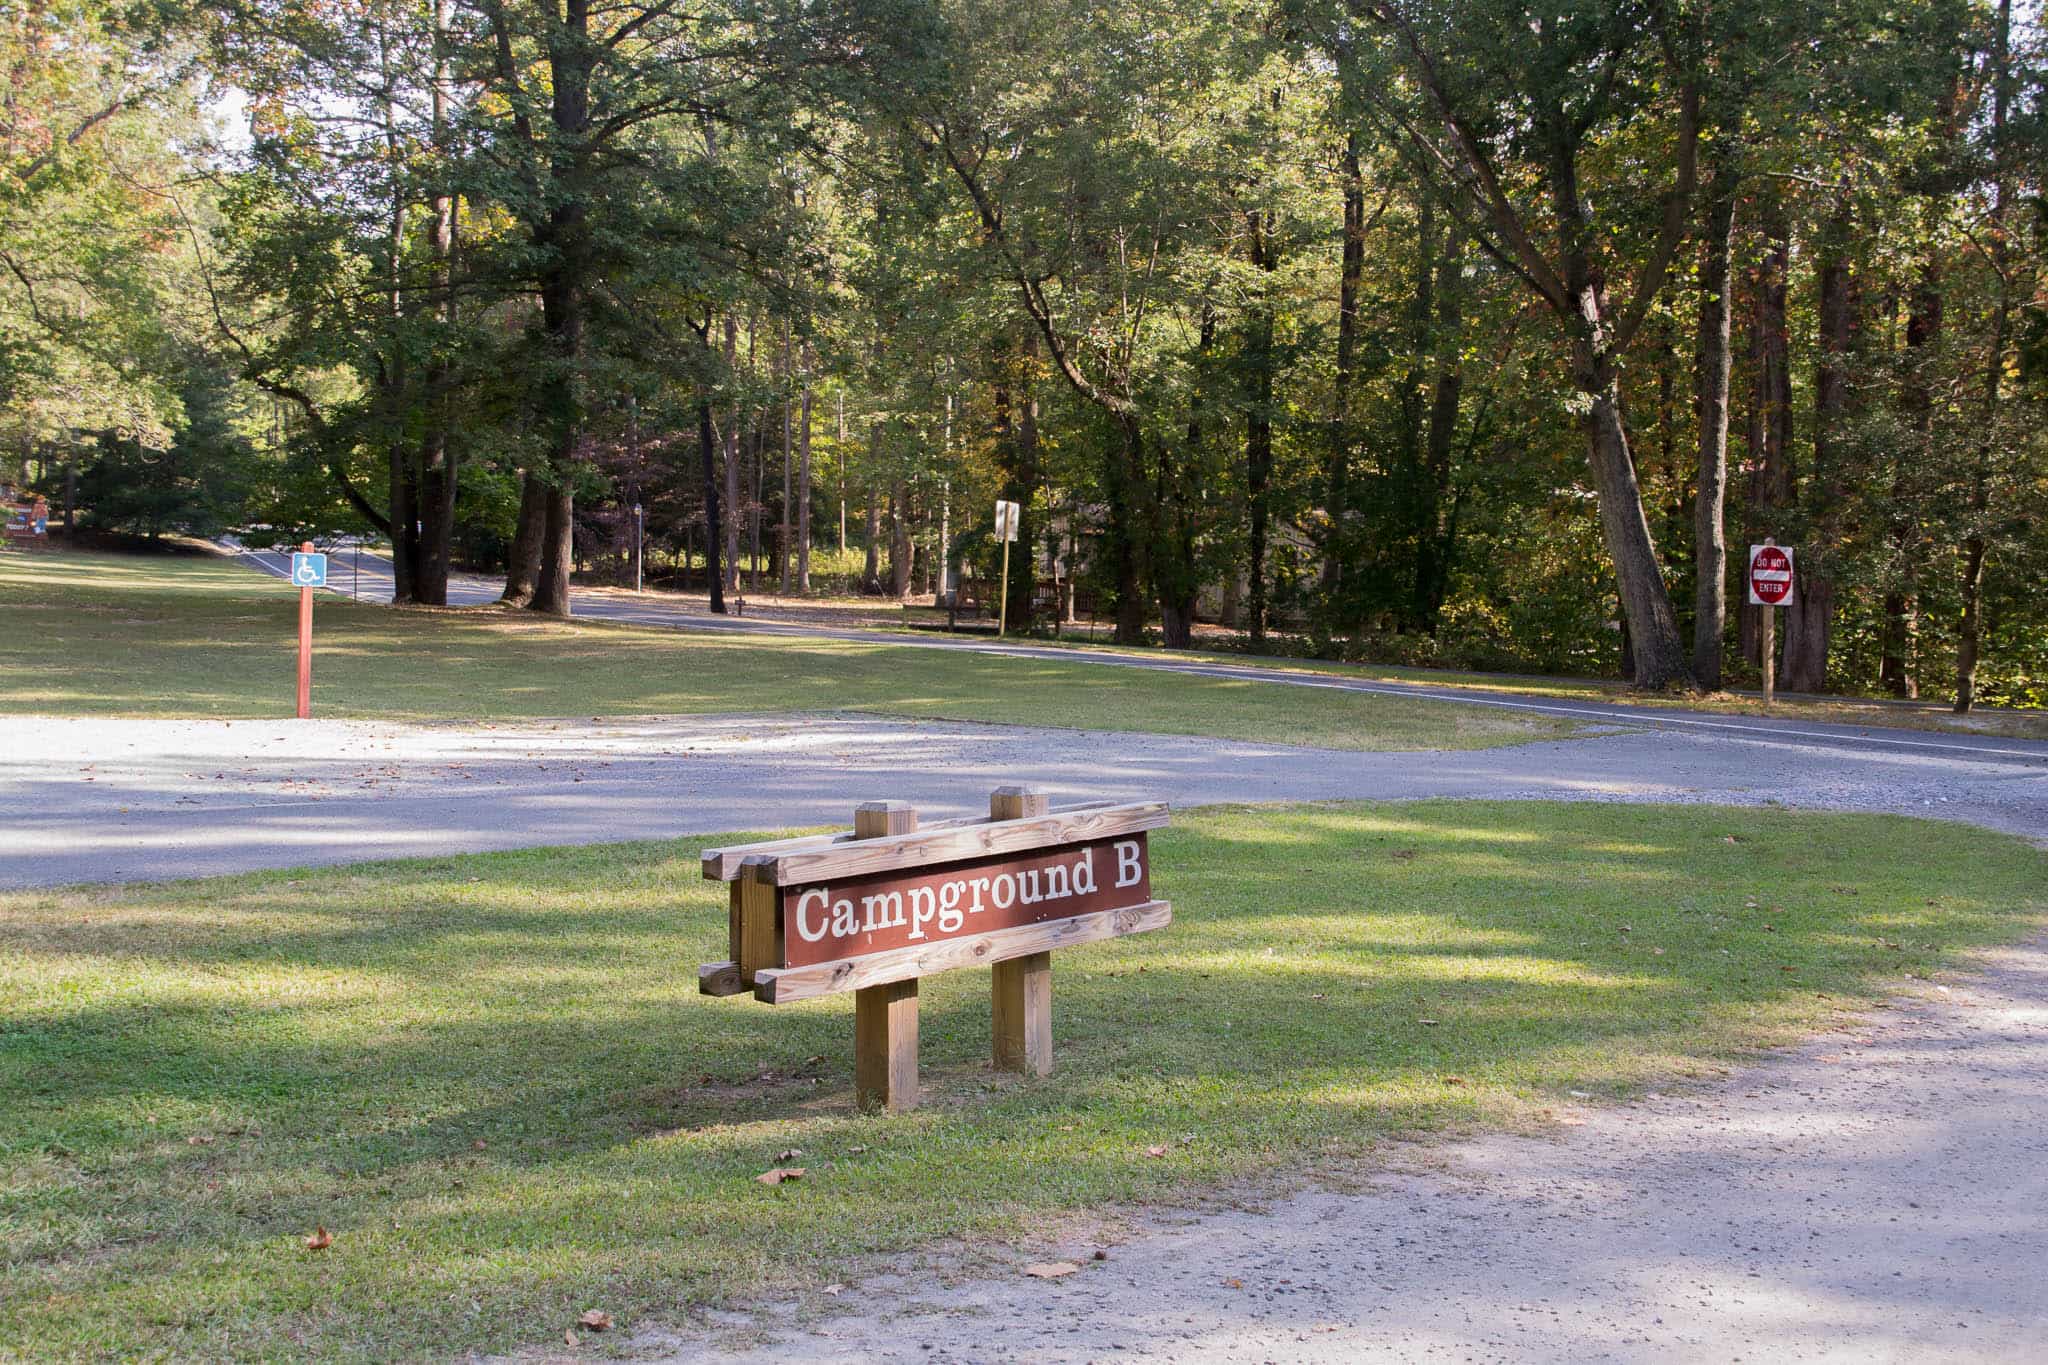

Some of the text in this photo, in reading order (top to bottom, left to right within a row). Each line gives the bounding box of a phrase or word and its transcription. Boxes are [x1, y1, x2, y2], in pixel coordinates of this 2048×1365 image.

[1757, 558, 1785, 568] DO NOT
[1760, 583, 1782, 592] ENTER
[796, 840, 1143, 942] Campground B
